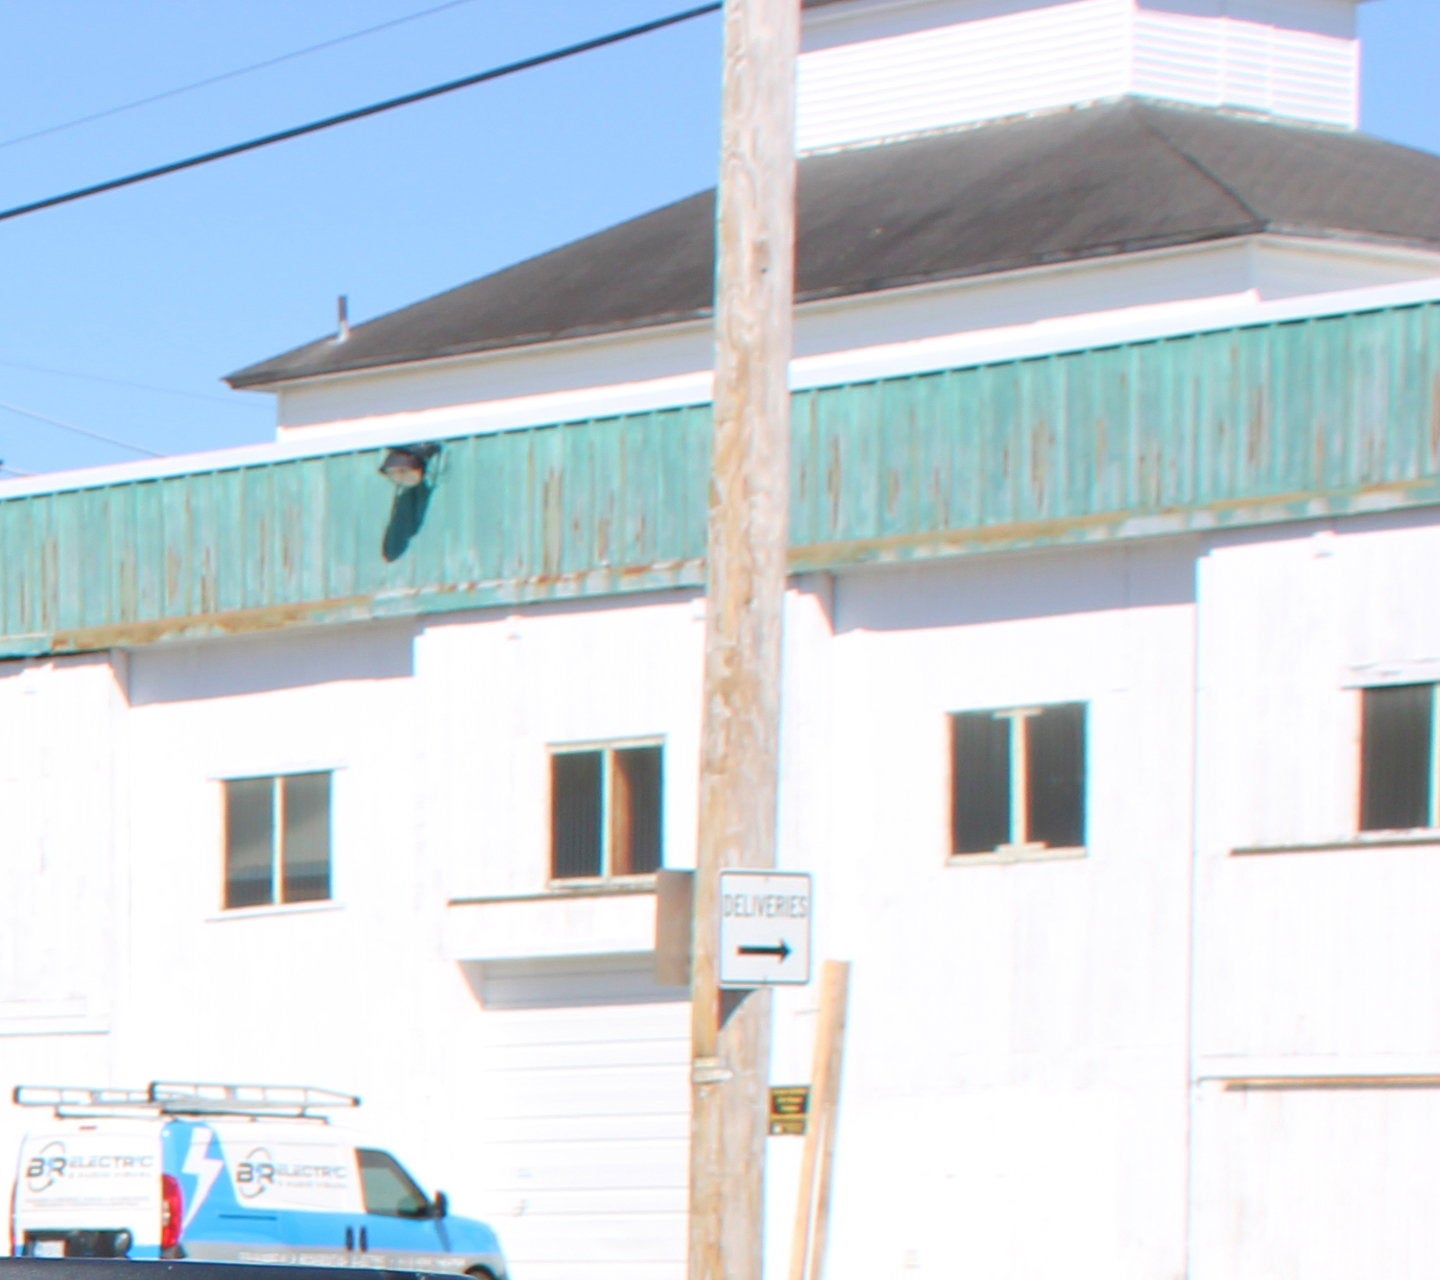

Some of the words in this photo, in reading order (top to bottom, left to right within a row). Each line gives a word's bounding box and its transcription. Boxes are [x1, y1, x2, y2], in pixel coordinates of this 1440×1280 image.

[723, 894, 808, 918] DELIVERIES
[26, 1157, 68, 1178] BR
[68, 1156, 154, 1168] ELECTRIC
[236, 1163, 275, 1183] BR
[276, 1163, 347, 1178] ELECTRIC
